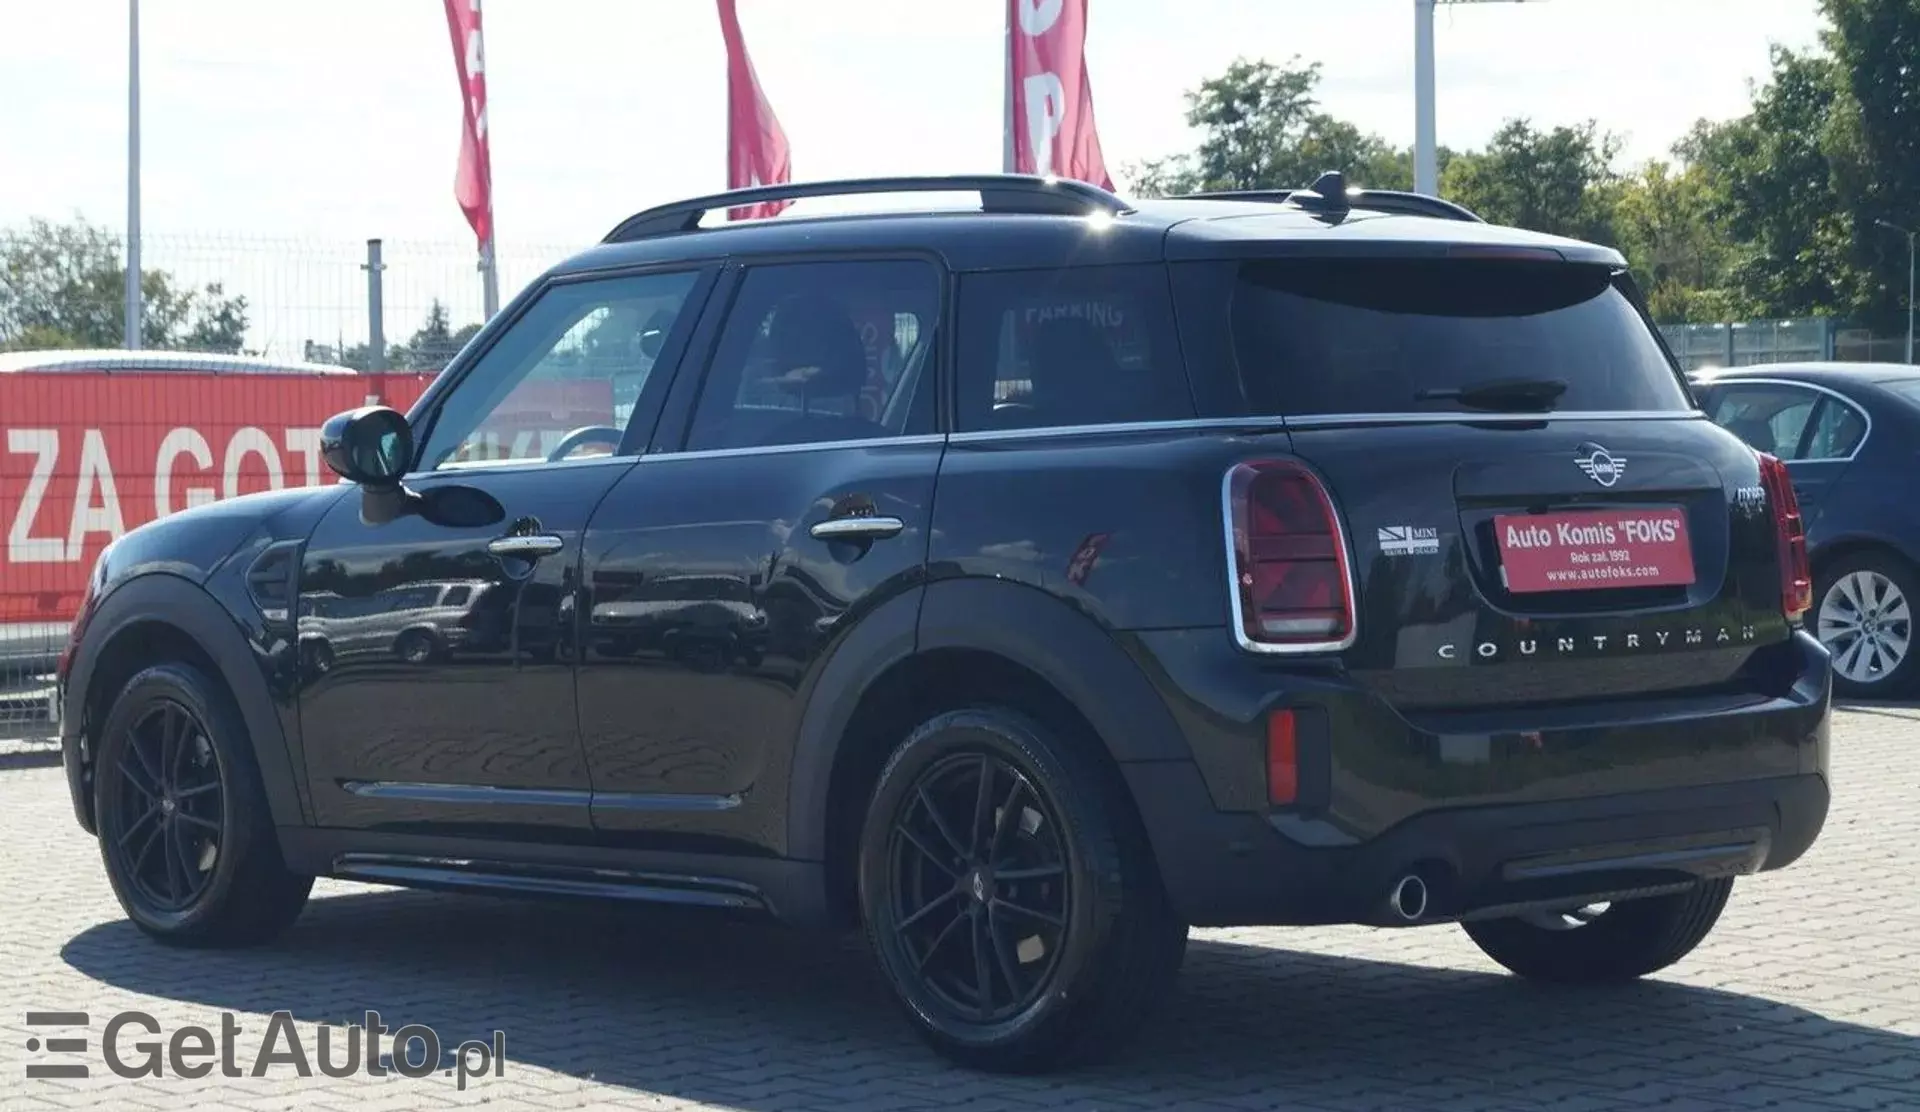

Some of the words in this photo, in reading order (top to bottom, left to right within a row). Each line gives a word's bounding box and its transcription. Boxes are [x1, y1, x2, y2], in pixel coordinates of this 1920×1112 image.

[8, 428, 127, 563] ZA
[1412, 527, 1437, 538] MINI
[1506, 525, 1552, 549] Auto
[1556, 522, 1616, 546] Komis
[1618, 519, 1680, 544] "FOKS"
[1570, 552, 1590, 564] Rok
[1610, 550, 1630, 562] 1992
[1546, 566, 1660, 582] www.autofoks.com
[1438, 625, 1754, 658] COUNTRYMAN
